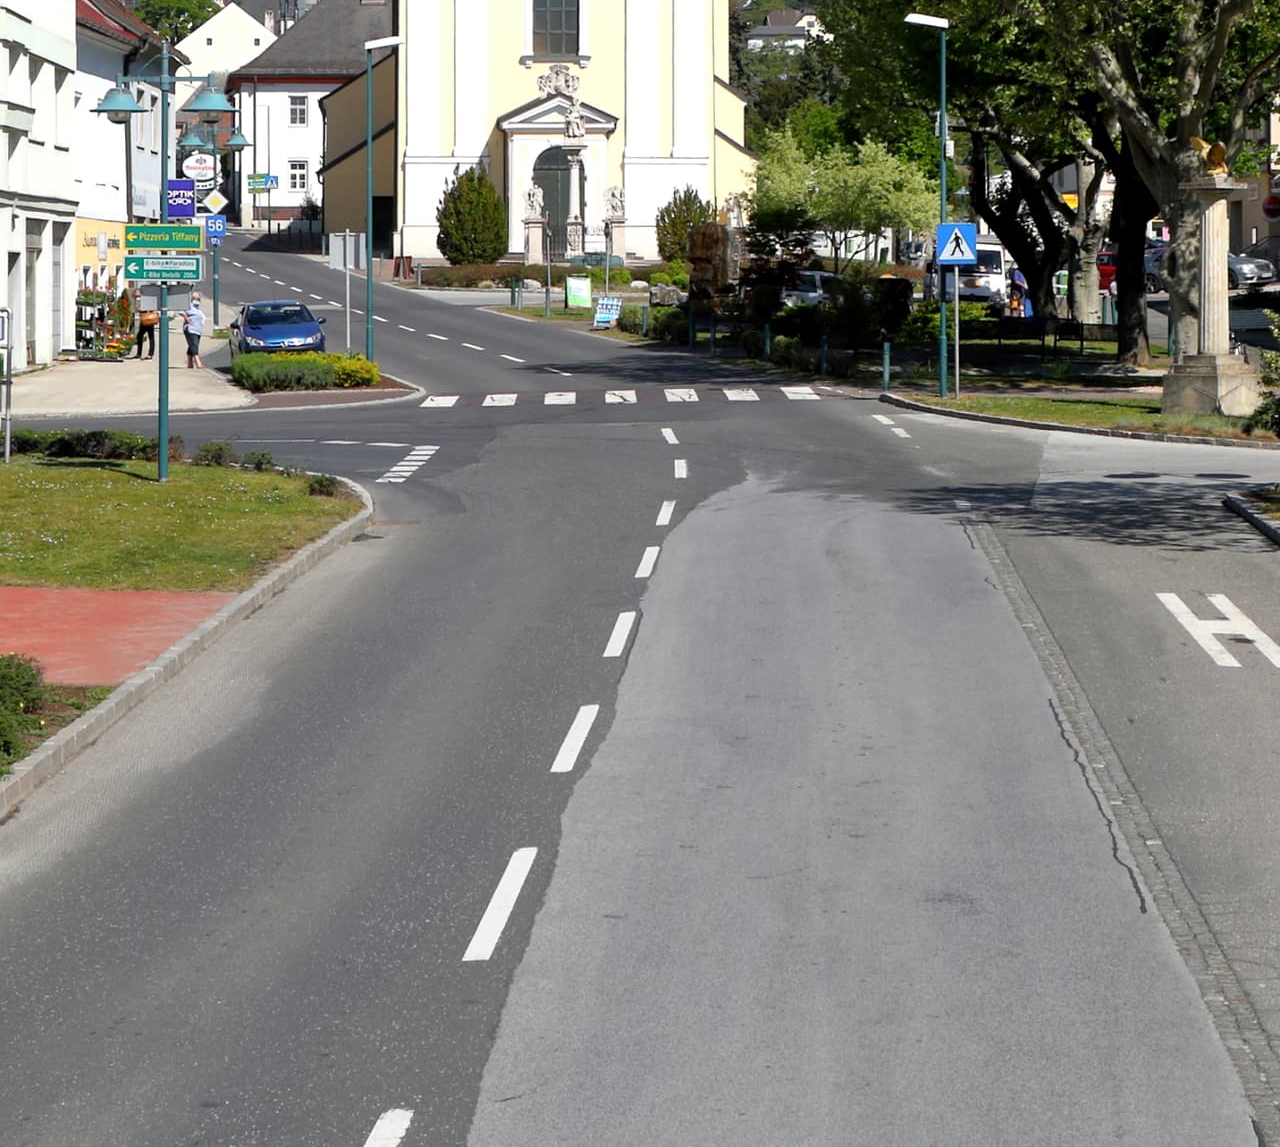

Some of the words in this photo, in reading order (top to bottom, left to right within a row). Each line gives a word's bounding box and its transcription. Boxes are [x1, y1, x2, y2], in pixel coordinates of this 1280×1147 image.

[207, 219, 223, 232] 56
[139, 232, 169, 242] Pizzeria
[172, 232, 199, 244] Tiffany
